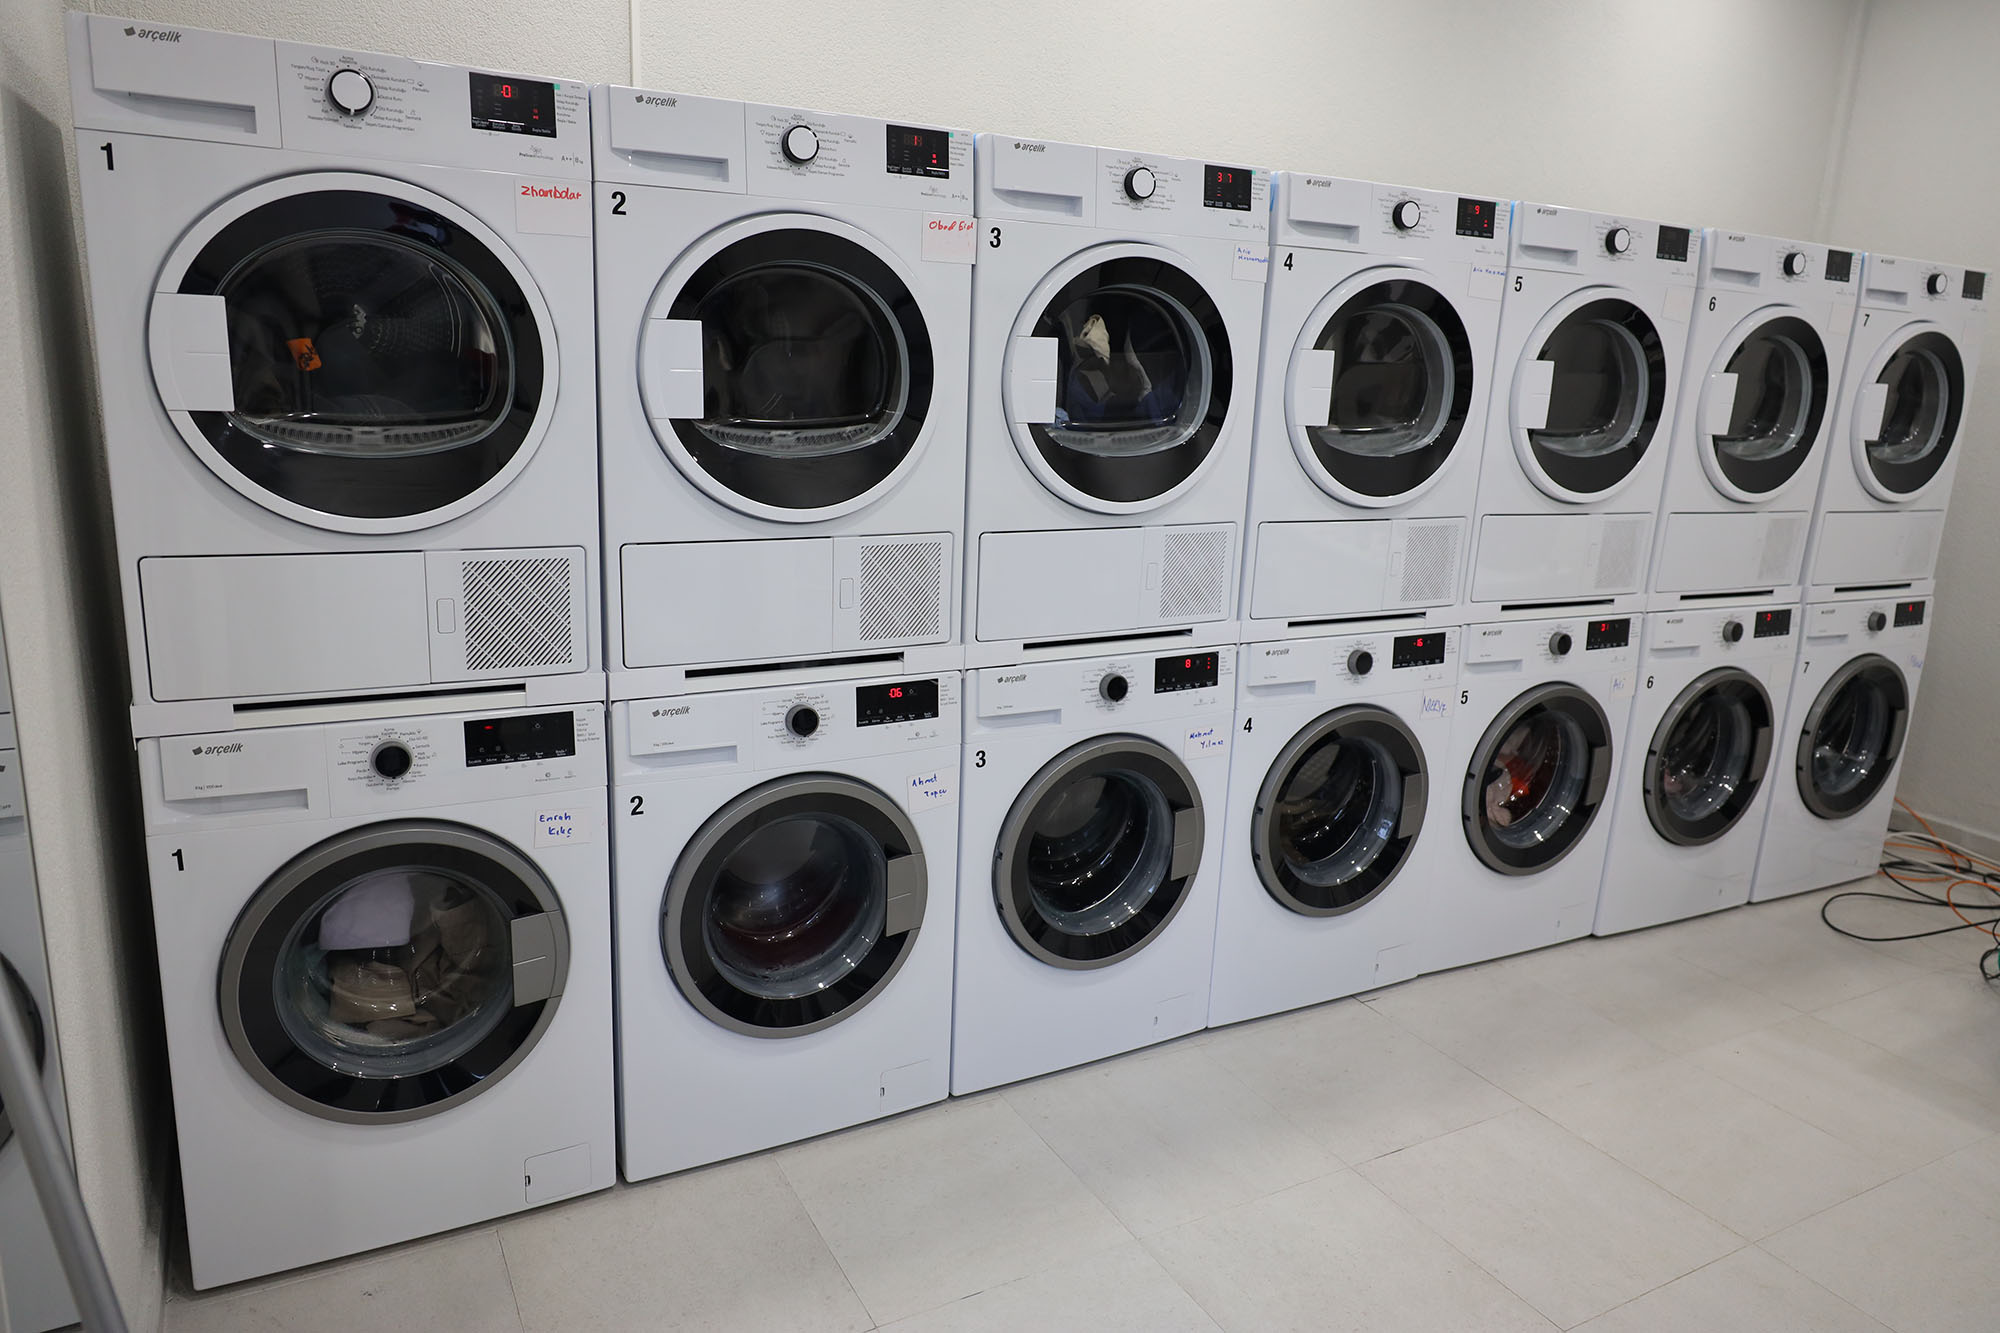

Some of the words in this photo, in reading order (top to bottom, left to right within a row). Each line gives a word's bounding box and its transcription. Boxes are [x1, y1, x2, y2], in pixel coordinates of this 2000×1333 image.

[138, 28, 182, 43] arçelik
[645, 96, 678, 108] arçelik
[1021, 143, 1046, 152] arçelik
[100, 142, 114, 171] 1
[611, 191, 627, 216] 2
[989, 227, 1002, 248] 3
[1284, 253, 1293, 271] 4
[1514, 276, 1523, 292] 5
[1709, 296, 1717, 312] 6
[1864, 313, 1870, 327] 7
[1804, 661, 1810, 673] 7
[1647, 675, 1654, 689] 6
[1460, 690, 1469, 705] 5
[661, 706, 691, 717] arçelik
[1243, 717, 1253, 733] 4
[204, 743, 244, 756] arçelik
[975, 750, 986, 768] 3
[630, 795, 644, 816] 2
[171, 848, 185, 872] 1
